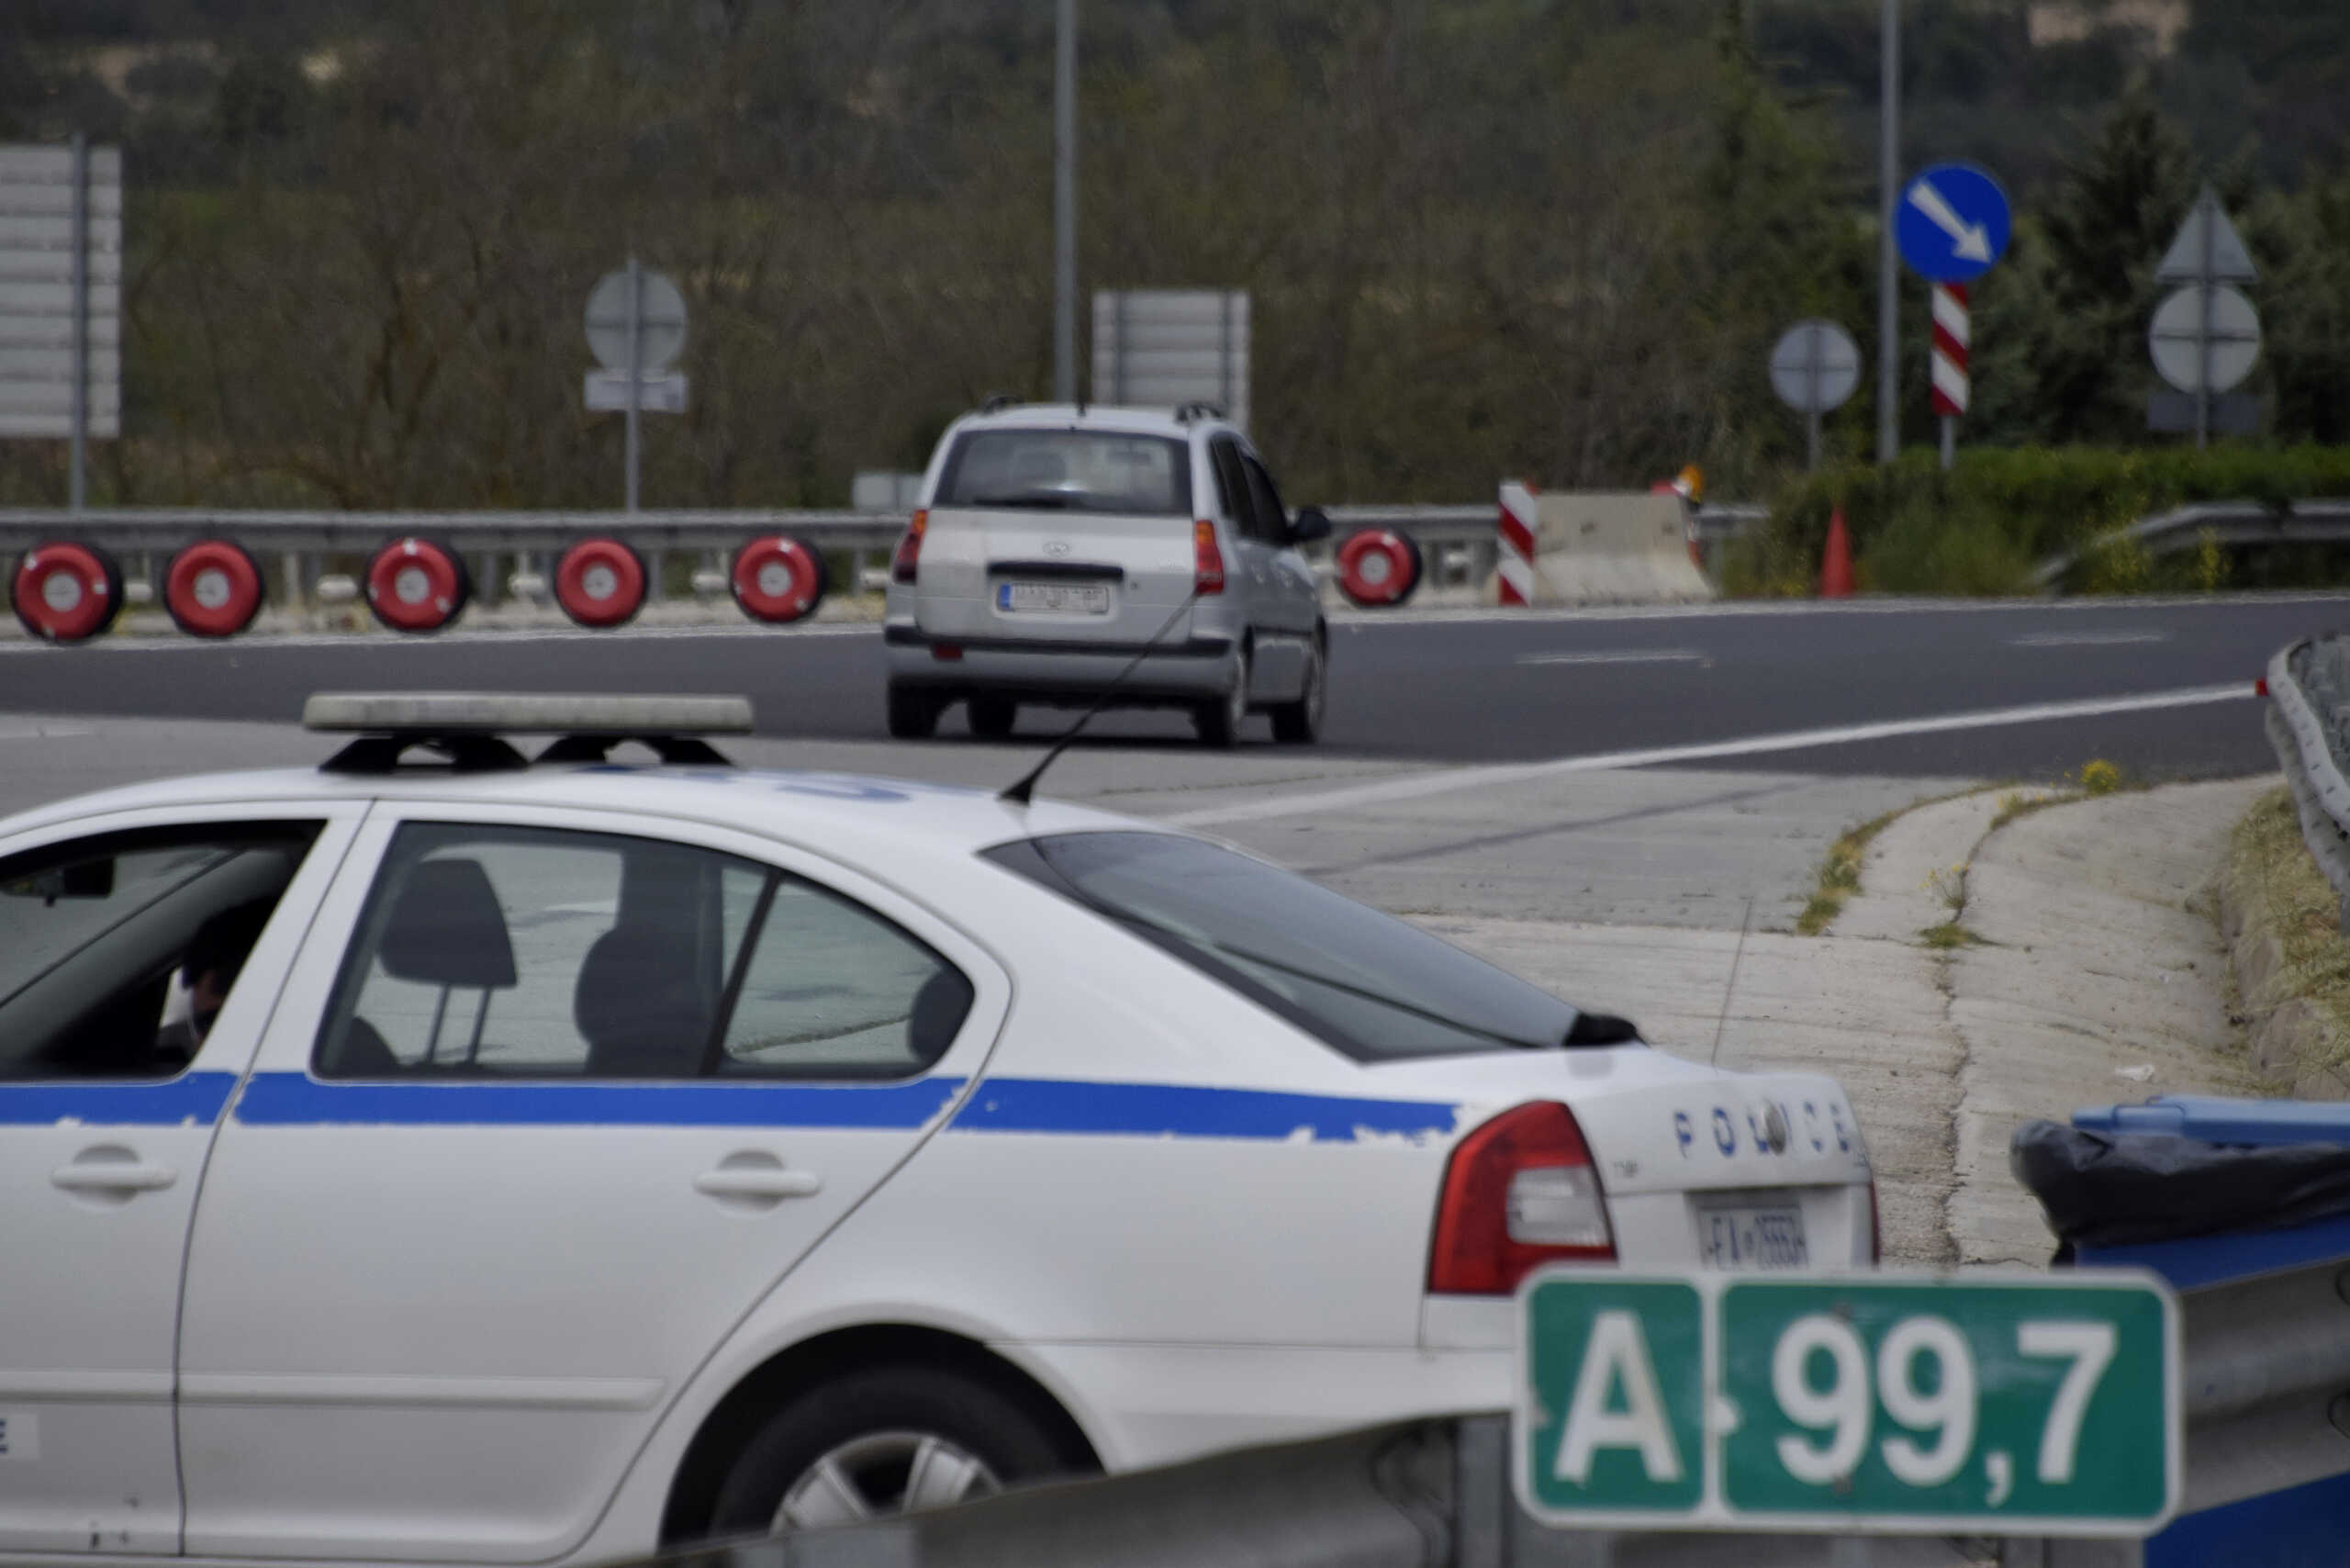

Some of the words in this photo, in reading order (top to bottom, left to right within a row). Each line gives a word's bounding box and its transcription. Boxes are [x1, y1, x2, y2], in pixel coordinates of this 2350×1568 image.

[1673, 1102, 1850, 1159] POLICE
[1553, 1308, 1685, 1484] A
[1771, 1314, 2118, 1507] 99,7
